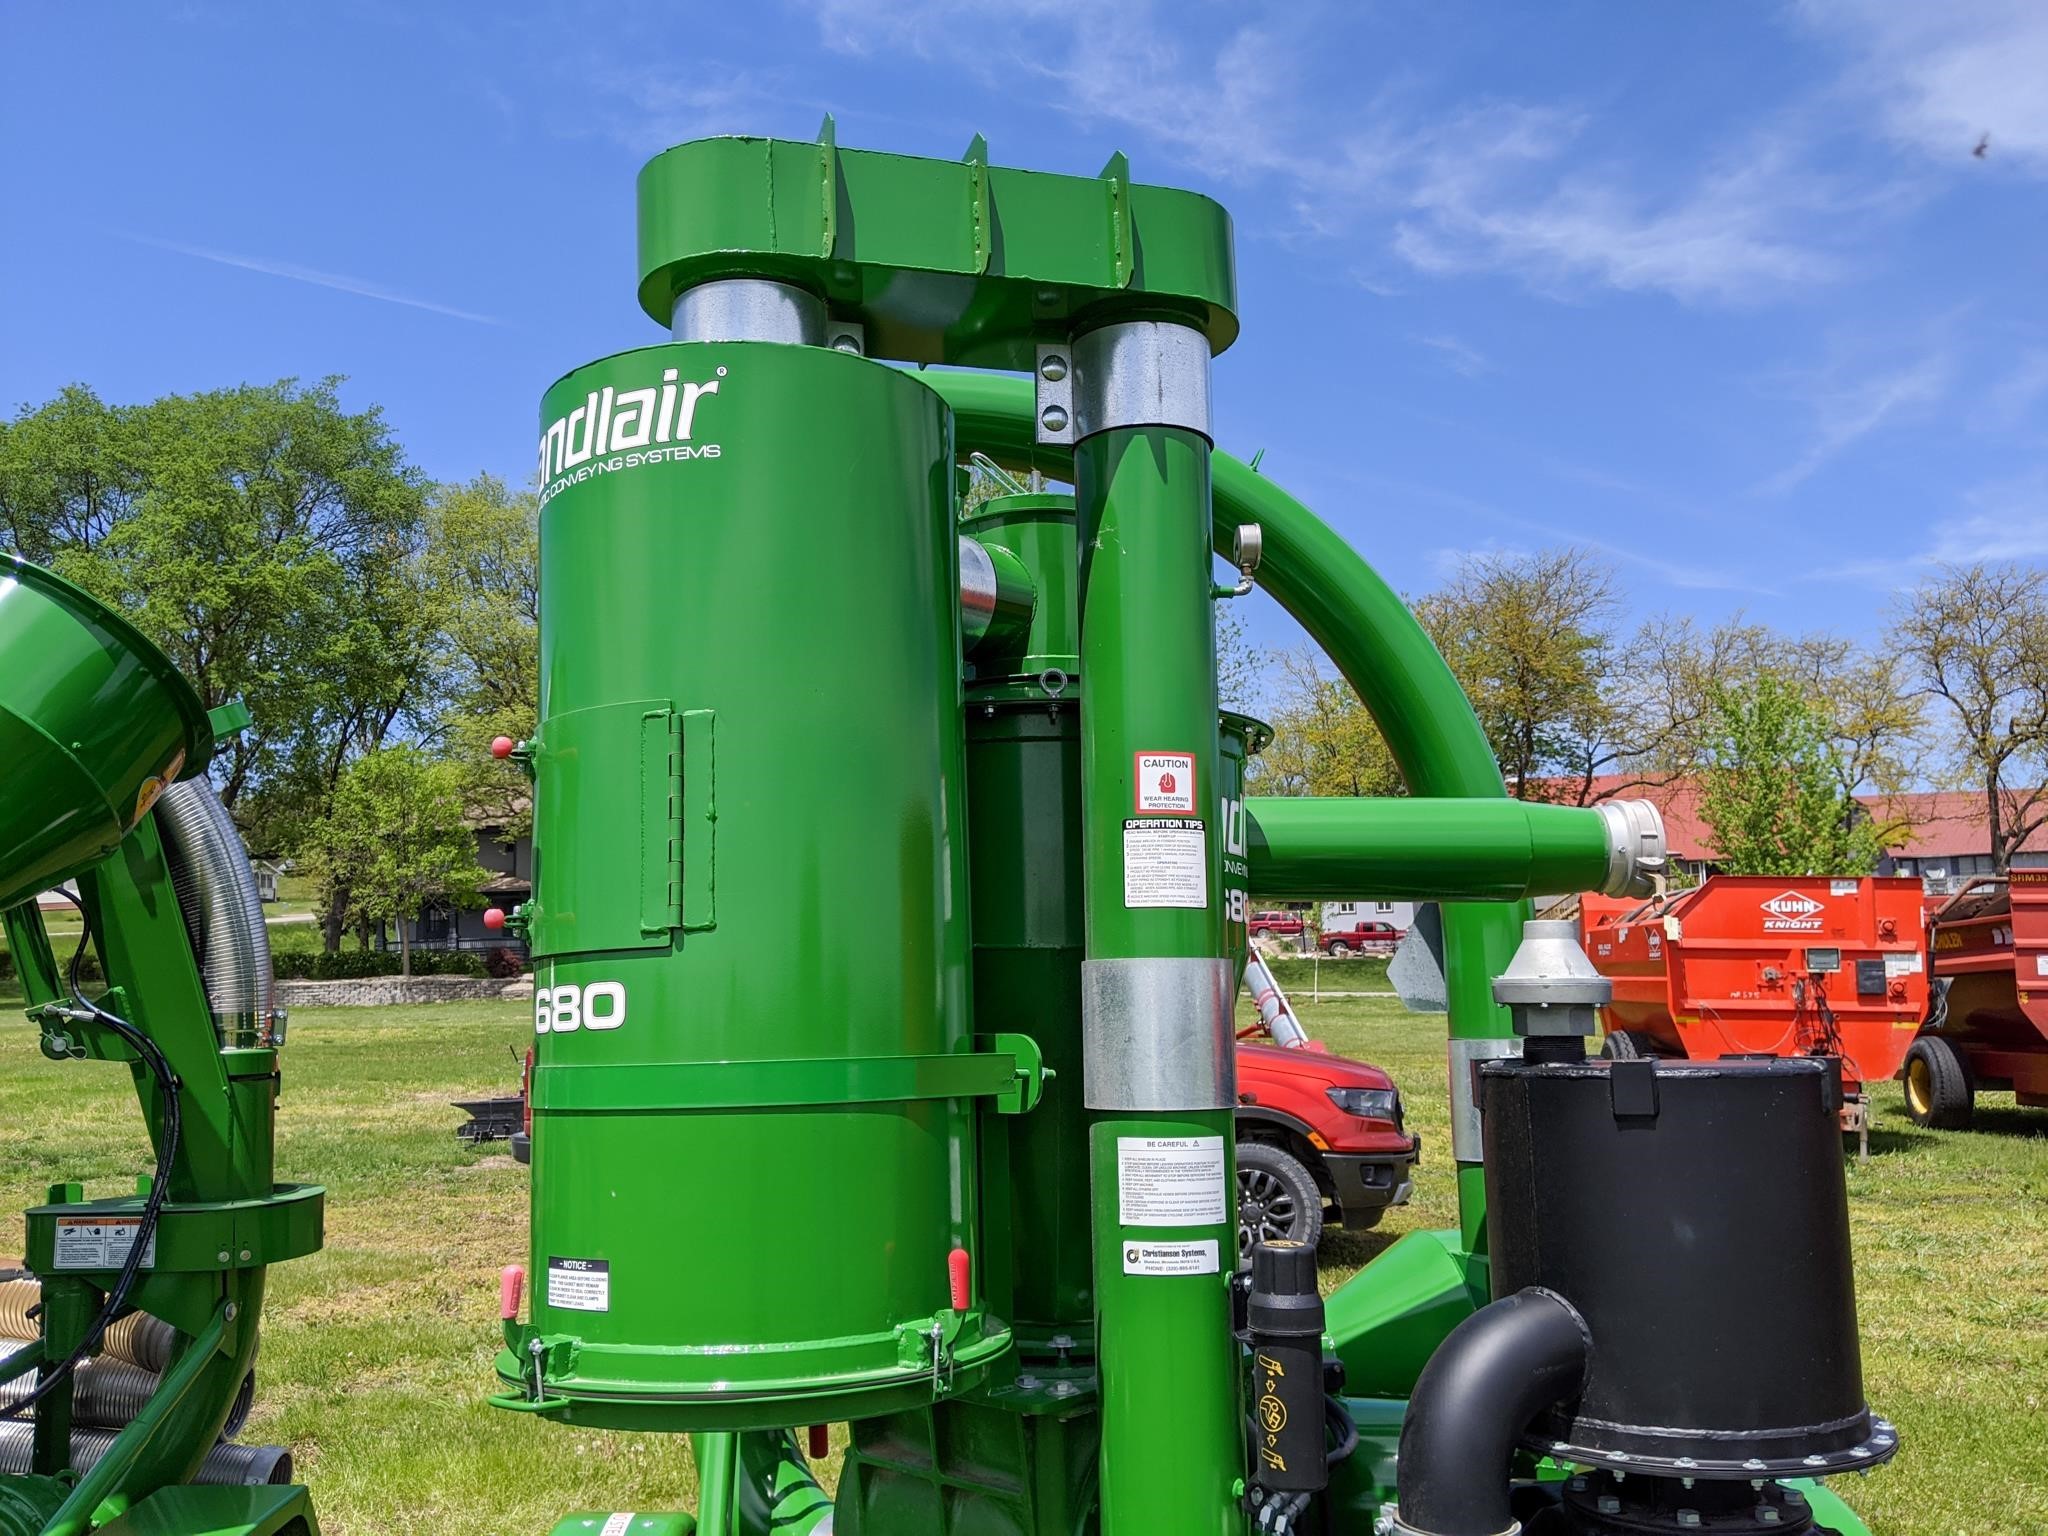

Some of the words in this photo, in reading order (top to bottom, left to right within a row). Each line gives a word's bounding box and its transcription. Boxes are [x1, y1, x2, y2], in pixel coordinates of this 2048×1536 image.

[626, 444, 721, 468] SYSTEMS
[1143, 759, 1189, 769] CAUTION
[1125, 819, 1182, 829] OPERATION
[1184, 820, 1203, 830] TIPS
[1769, 900, 1816, 913] KUHN
[1764, 921, 1822, 929] KNIGHT
[536, 981, 626, 1034] 680
[1142, 1249, 1180, 1258] Christianson
